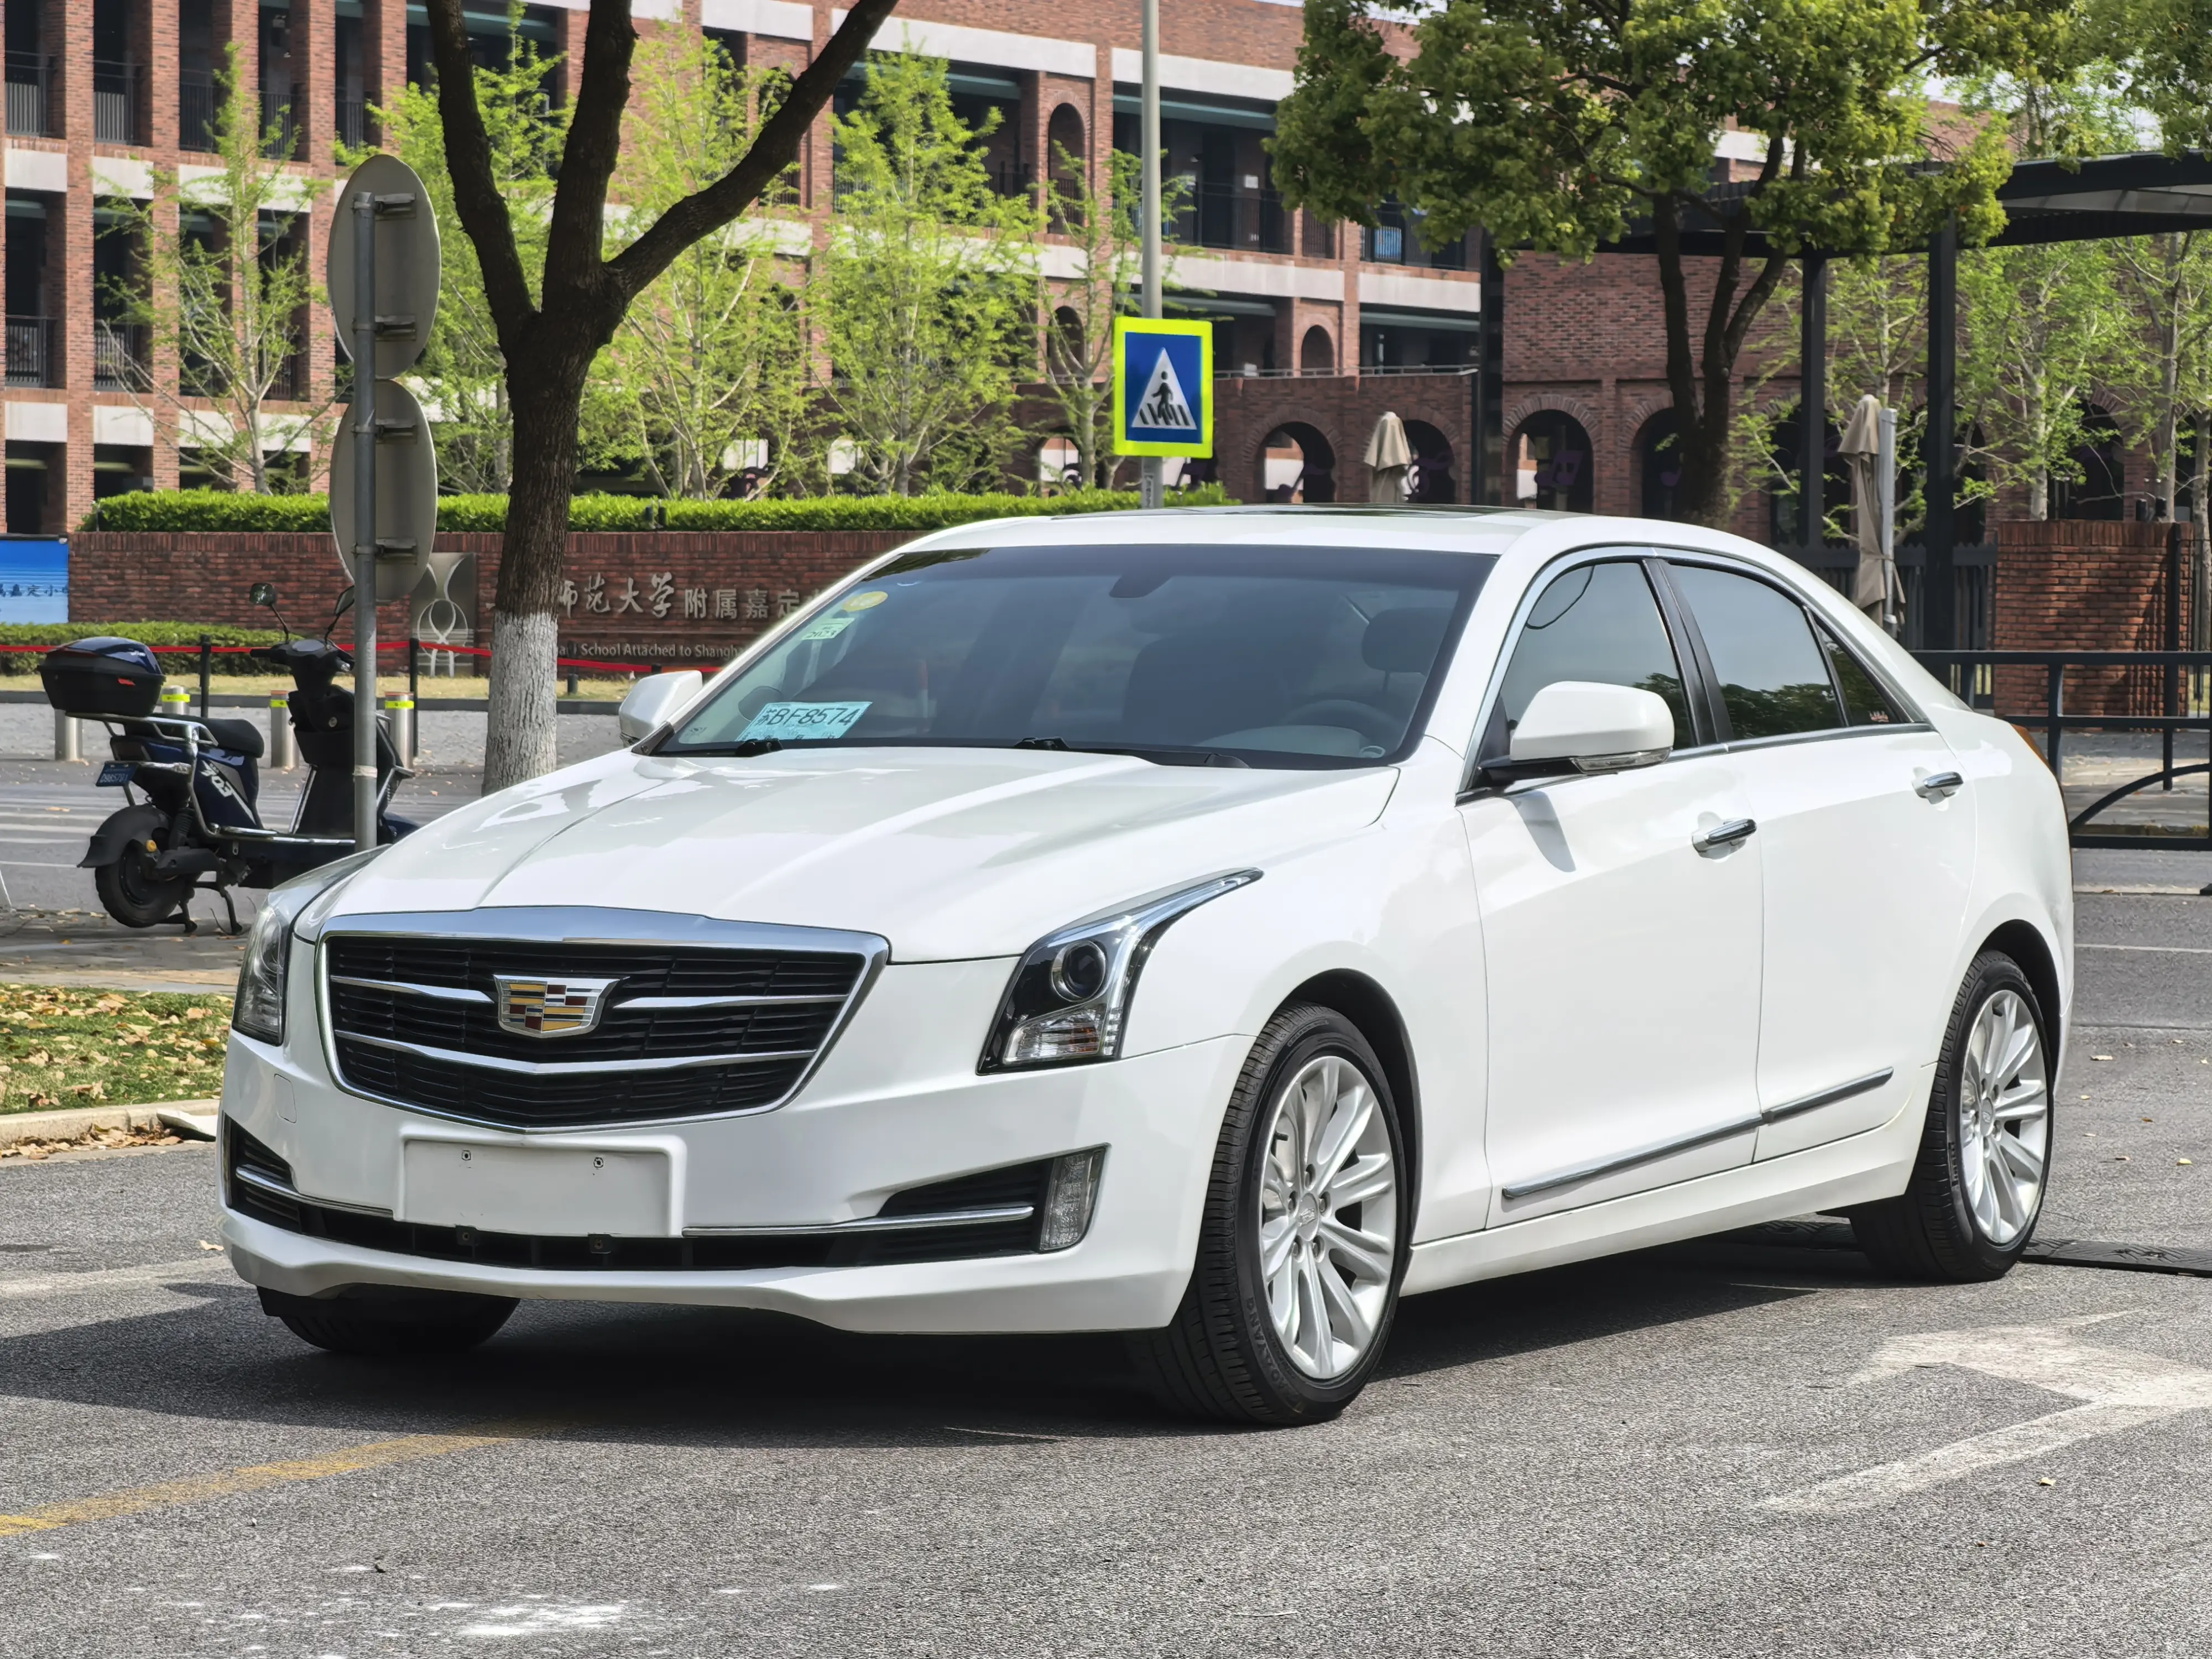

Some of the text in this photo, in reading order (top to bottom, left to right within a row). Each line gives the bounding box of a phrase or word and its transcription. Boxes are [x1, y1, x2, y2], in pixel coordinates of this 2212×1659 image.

[557, 572, 820, 619] 师范大学附属嘉定
[581, 643, 620, 656] School
[623, 643, 676, 656] Attached
[679, 645, 692, 657] to
